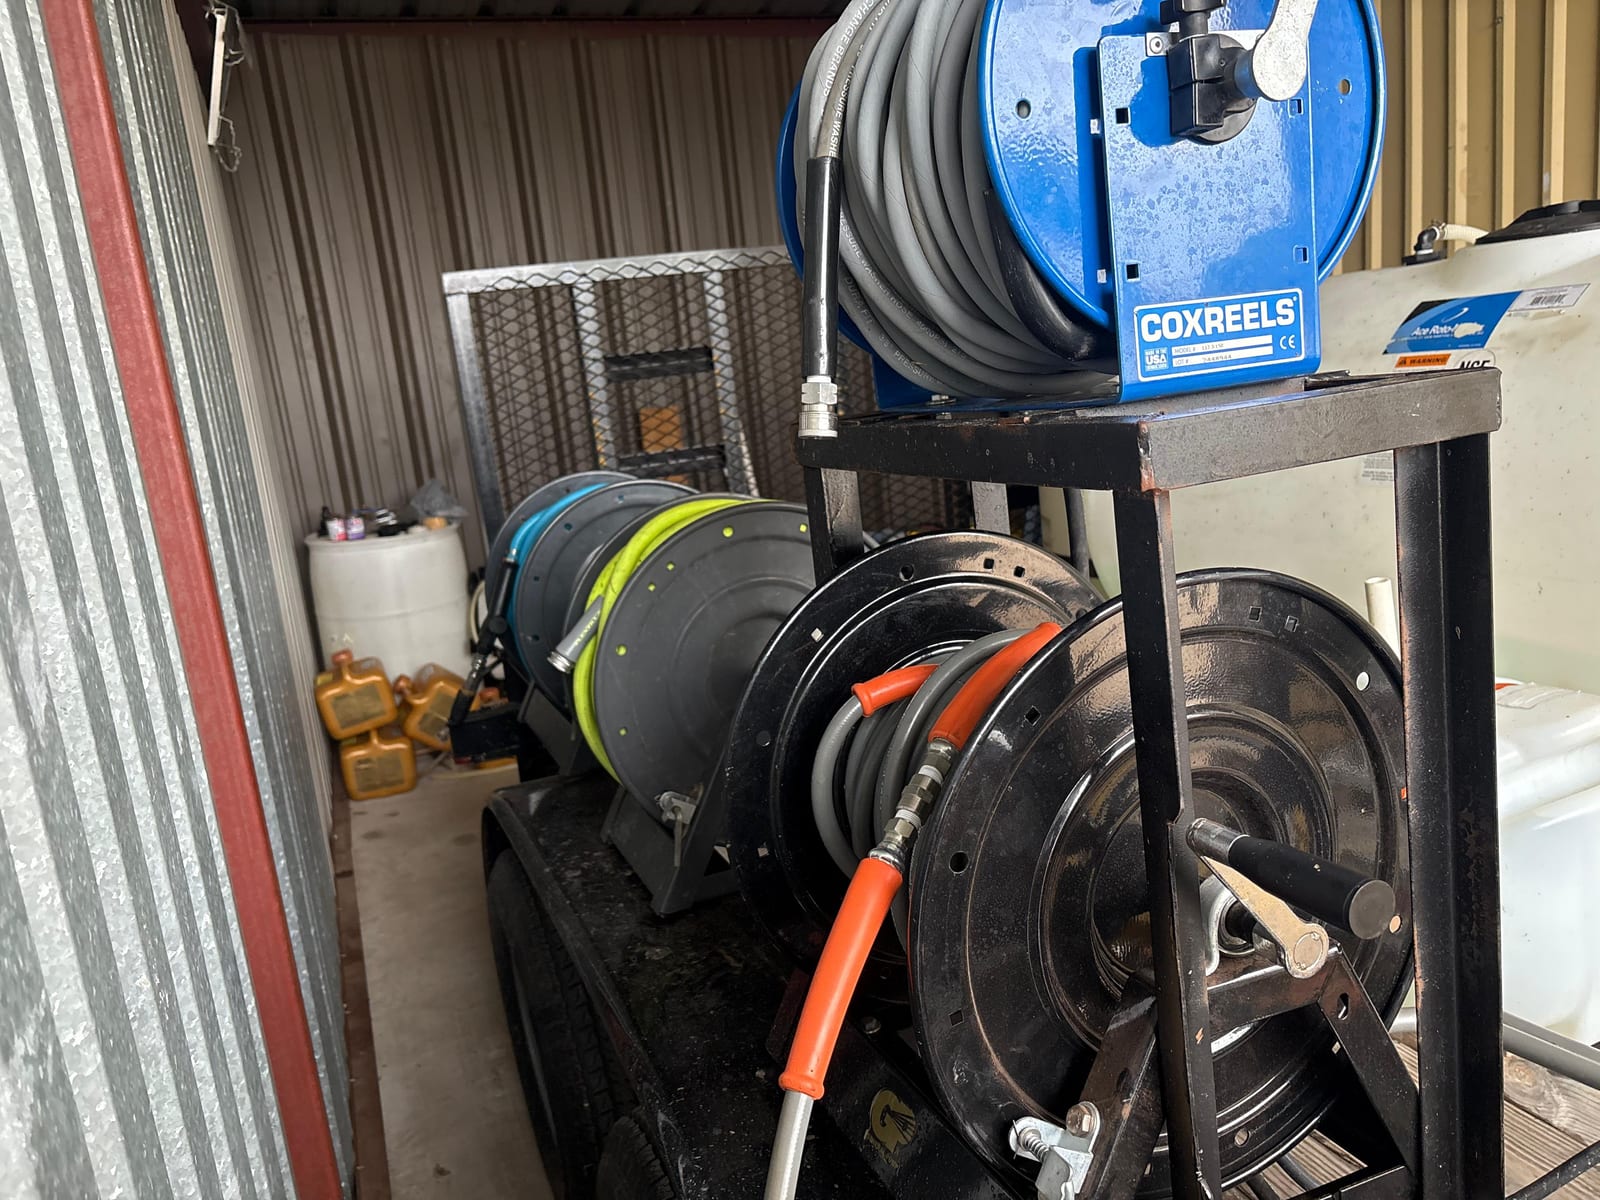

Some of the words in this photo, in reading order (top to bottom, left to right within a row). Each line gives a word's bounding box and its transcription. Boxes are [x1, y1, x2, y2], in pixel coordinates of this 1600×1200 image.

[823, 45, 845, 97] BRANDS
[836, 65, 855, 118] ESSURE
[1140, 298, 1296, 343] COXREELS
[1145, 353, 1167, 365] USA
